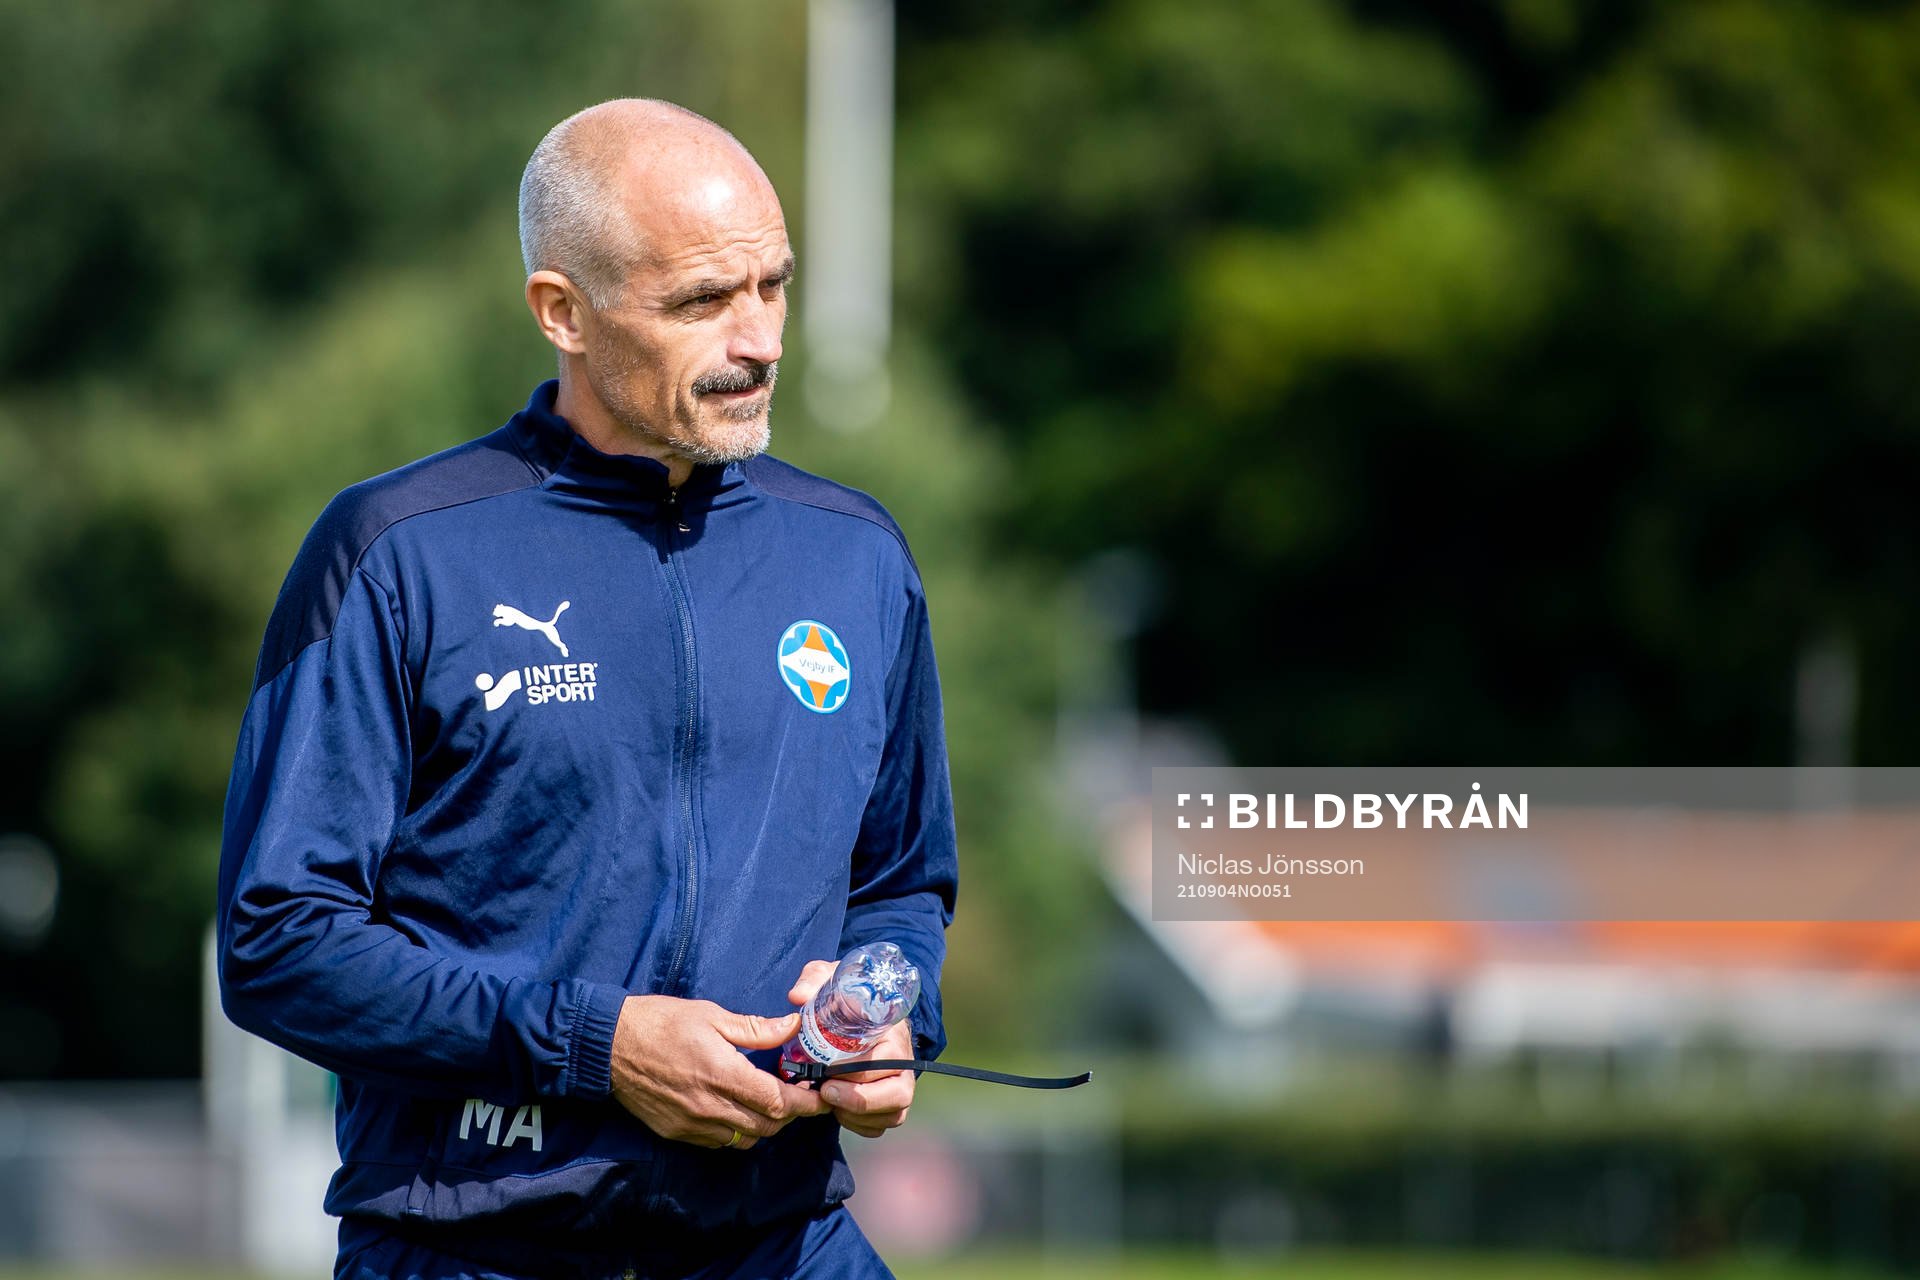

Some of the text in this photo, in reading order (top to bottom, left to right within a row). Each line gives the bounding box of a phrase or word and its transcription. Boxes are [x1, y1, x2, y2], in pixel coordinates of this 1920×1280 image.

[524, 663, 598, 686] INTER
[828, 665, 836, 673] IF
[526, 682, 597, 705] SPORT
[459, 1099, 543, 1152] MA
